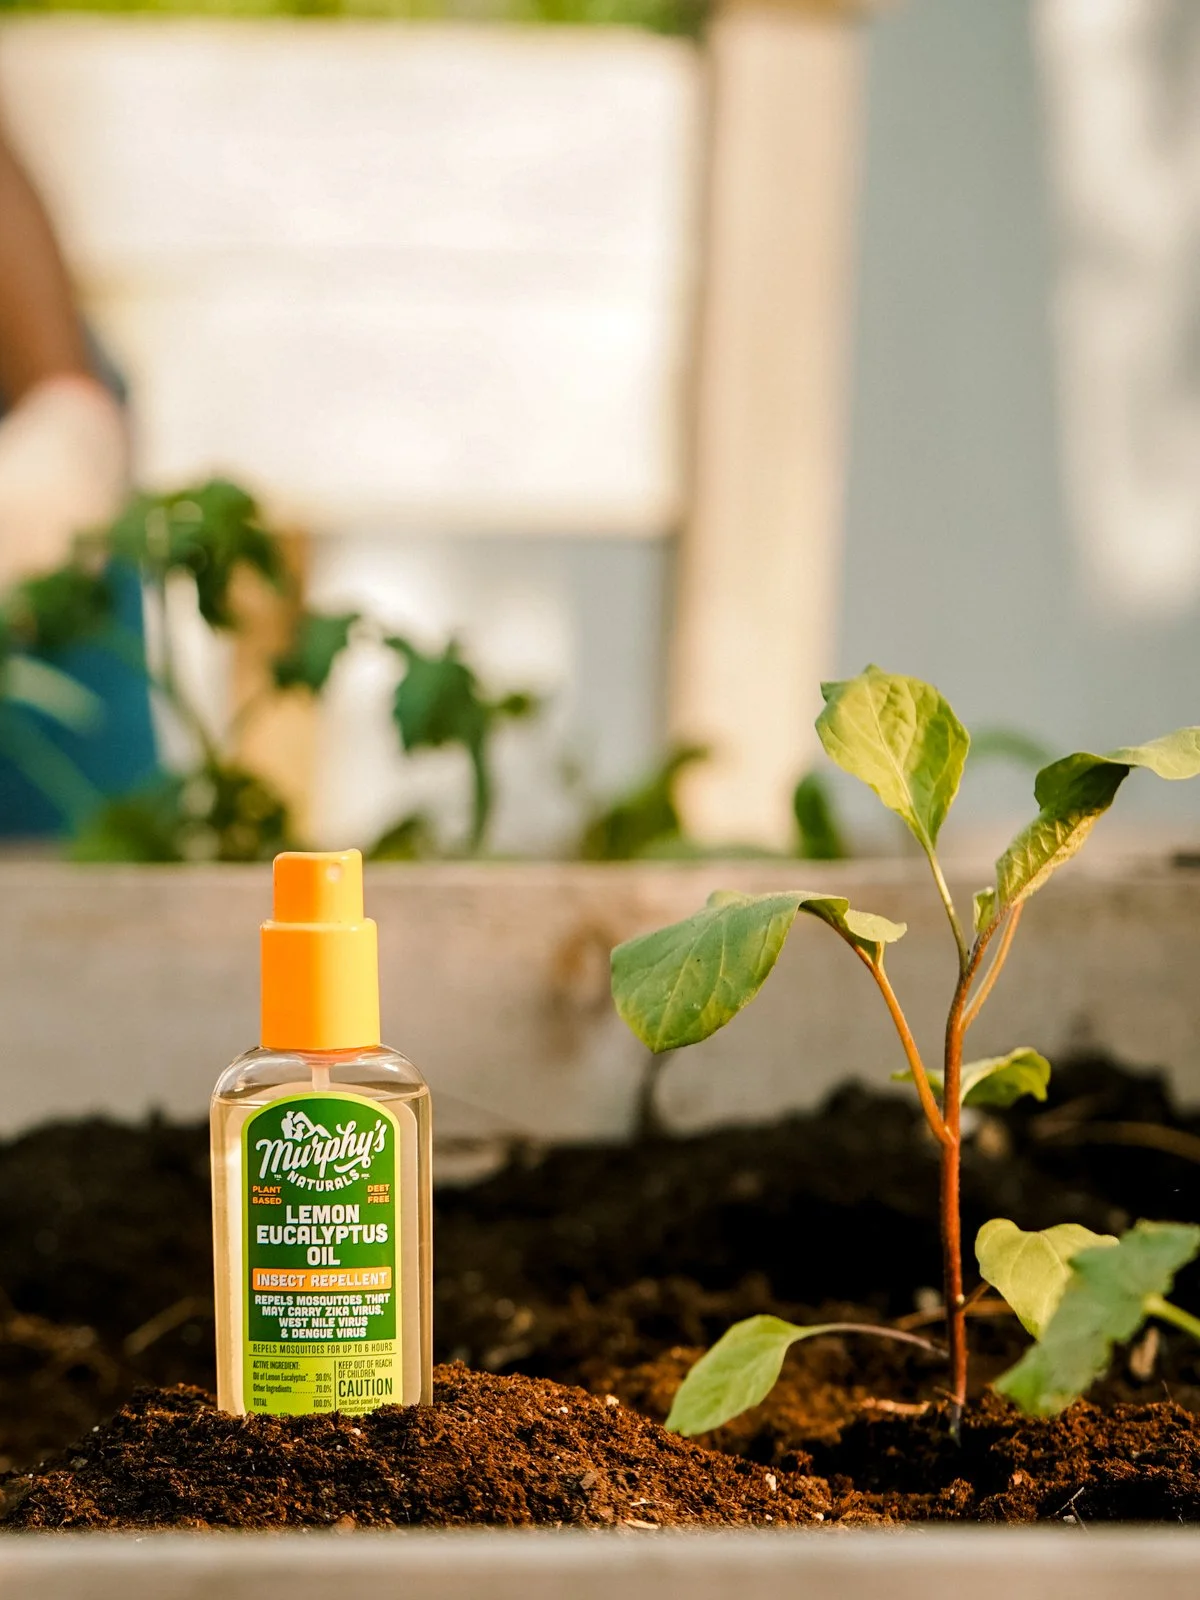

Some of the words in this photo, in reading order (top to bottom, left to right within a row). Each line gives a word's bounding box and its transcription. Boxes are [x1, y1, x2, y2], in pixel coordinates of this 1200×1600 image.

[255, 1119, 387, 1179] Murphy's
[287, 1169, 359, 1192] NATURALS
[252, 1185, 281, 1194] PLANT
[367, 1184, 390, 1193] DEET
[252, 1197, 282, 1205] BASED
[367, 1195, 390, 1204] FREE
[286, 1204, 359, 1224] LEMON
[256, 1223, 388, 1244] EUCALYPTUS
[307, 1246, 340, 1266] OIL
[257, 1273, 306, 1287] INSECT
[310, 1271, 388, 1287] REPELLENT
[254, 1294, 293, 1305] REPELS
[296, 1294, 362, 1306] MOSQUITOES
[365, 1293, 390, 1304] THAT
[262, 1306, 284, 1316] MAY
[288, 1306, 322, 1317] CARRY
[325, 1306, 350, 1316] ZIKA
[352, 1305, 384, 1316] VIRUS,
[279, 1317, 309, 1328] WEST
[312, 1317, 335, 1327] NILE
[338, 1316, 368, 1327] VIRUS
[281, 1328, 288, 1338] &
[292, 1328, 333, 1339] DENGUE
[336, 1327, 366, 1338] VIRUS
[253, 1343, 277, 1353] REPELS
[280, 1344, 325, 1354] MOSQUITOES
[327, 1344, 340, 1353] FOR
[343, 1343, 352, 1353] UP
[354, 1343, 362, 1352] TO
[364, 1343, 370, 1352] 6
[371, 1342, 392, 1352] HOURS
[253, 1361, 269, 1369] ACTIVE
[338, 1361, 353, 1369] KEEP
[354, 1360, 365, 1369] OUT
[366, 1360, 374, 1368] OF
[375, 1358, 392, 1368] REACH
[266, 1373, 280, 1381] Lemon
[315, 1373, 331, 1382] 30.0%
[338, 1370, 346, 1378] OF
[347, 1369, 376, 1378] CHILDREN
[315, 1385, 331, 1393] 70.0%
[338, 1377, 393, 1397] CAUTION
[253, 1398, 267, 1407] TOTAL
